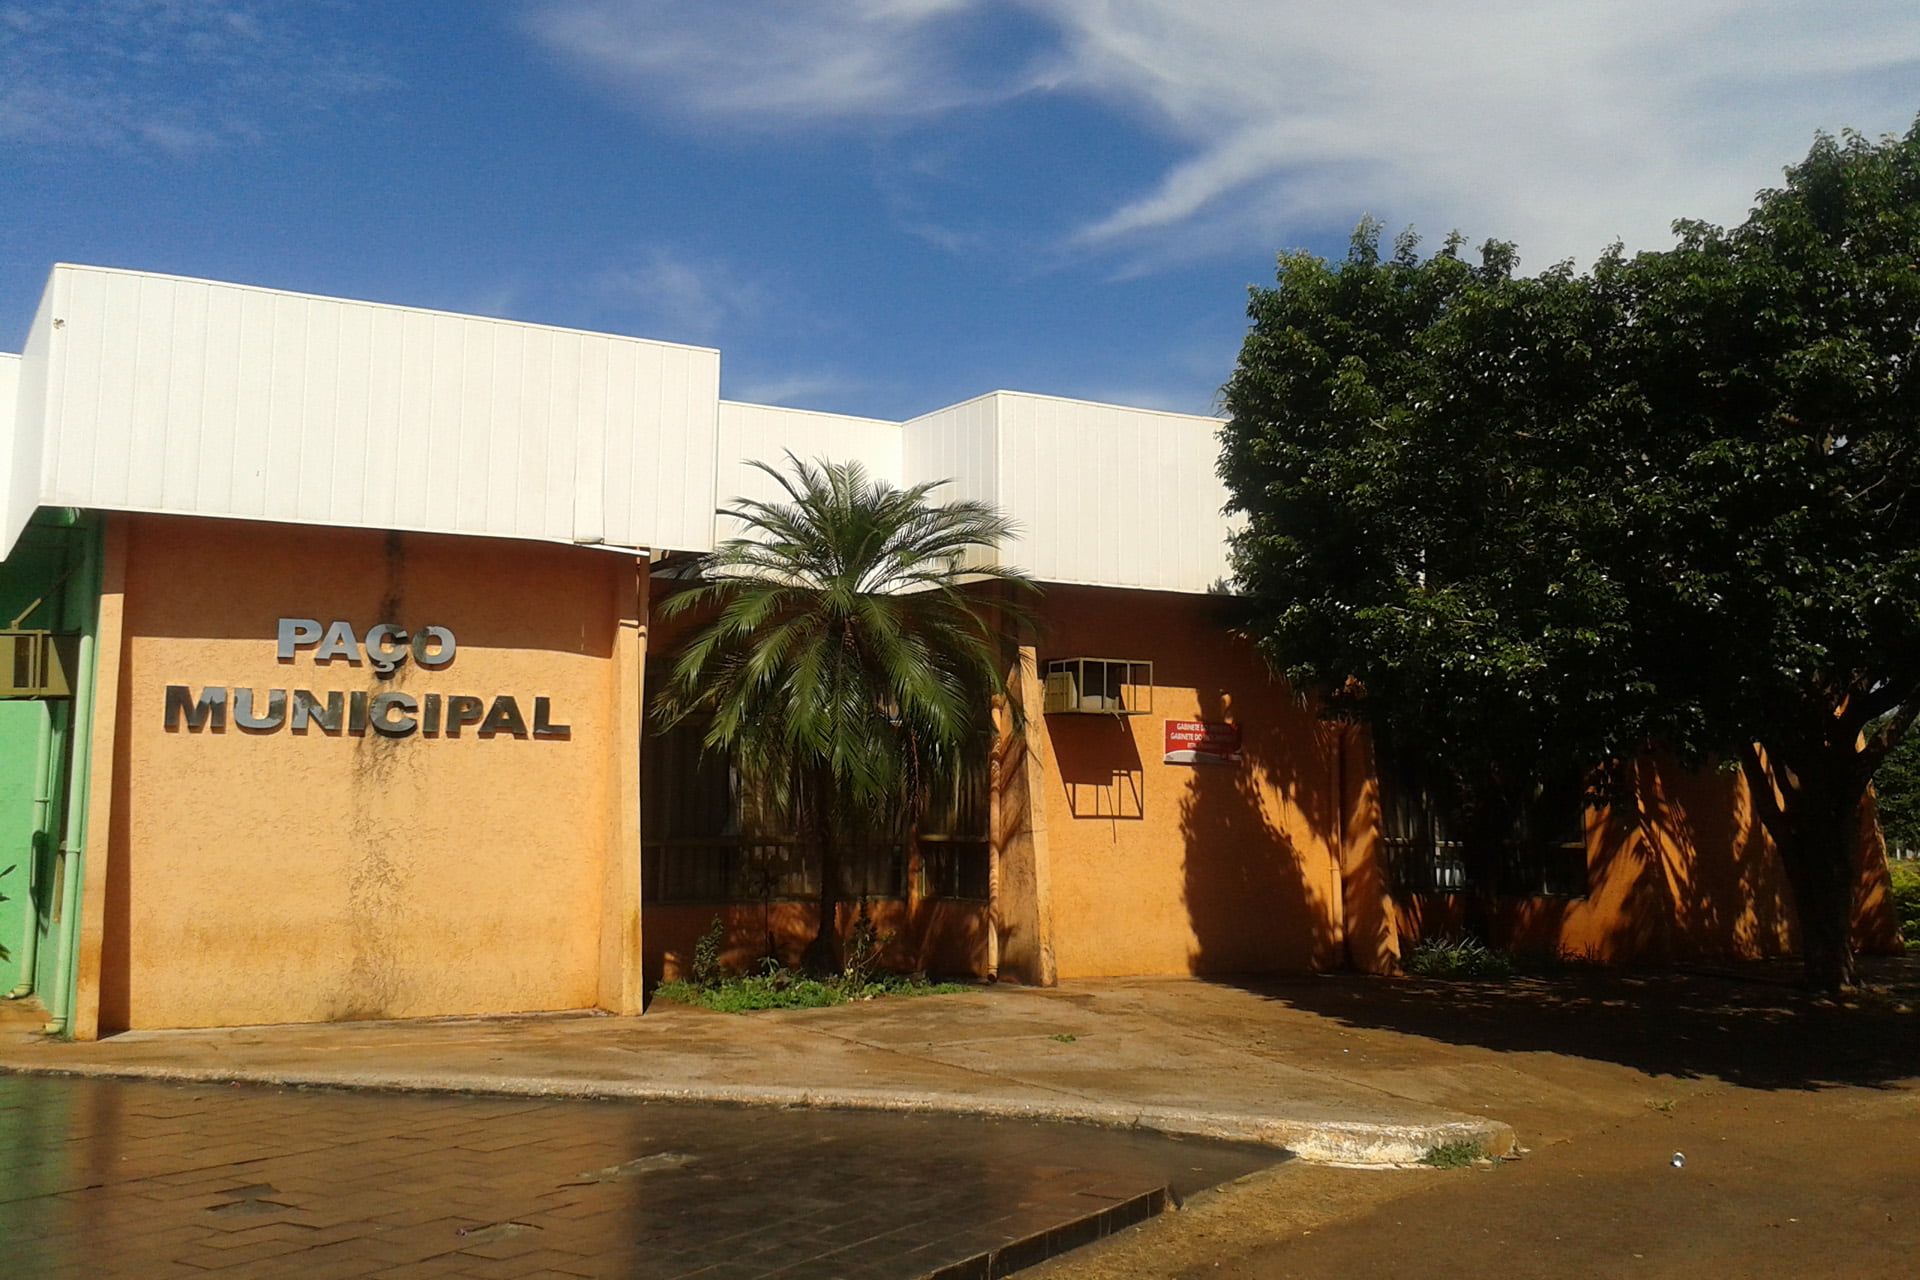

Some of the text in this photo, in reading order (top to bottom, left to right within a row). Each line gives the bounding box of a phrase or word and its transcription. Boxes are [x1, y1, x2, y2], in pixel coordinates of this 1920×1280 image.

[277, 618, 457, 675] PAÇO
[164, 685, 571, 740] MUNICIPAL
[1170, 732, 1193, 741] GABINETE
